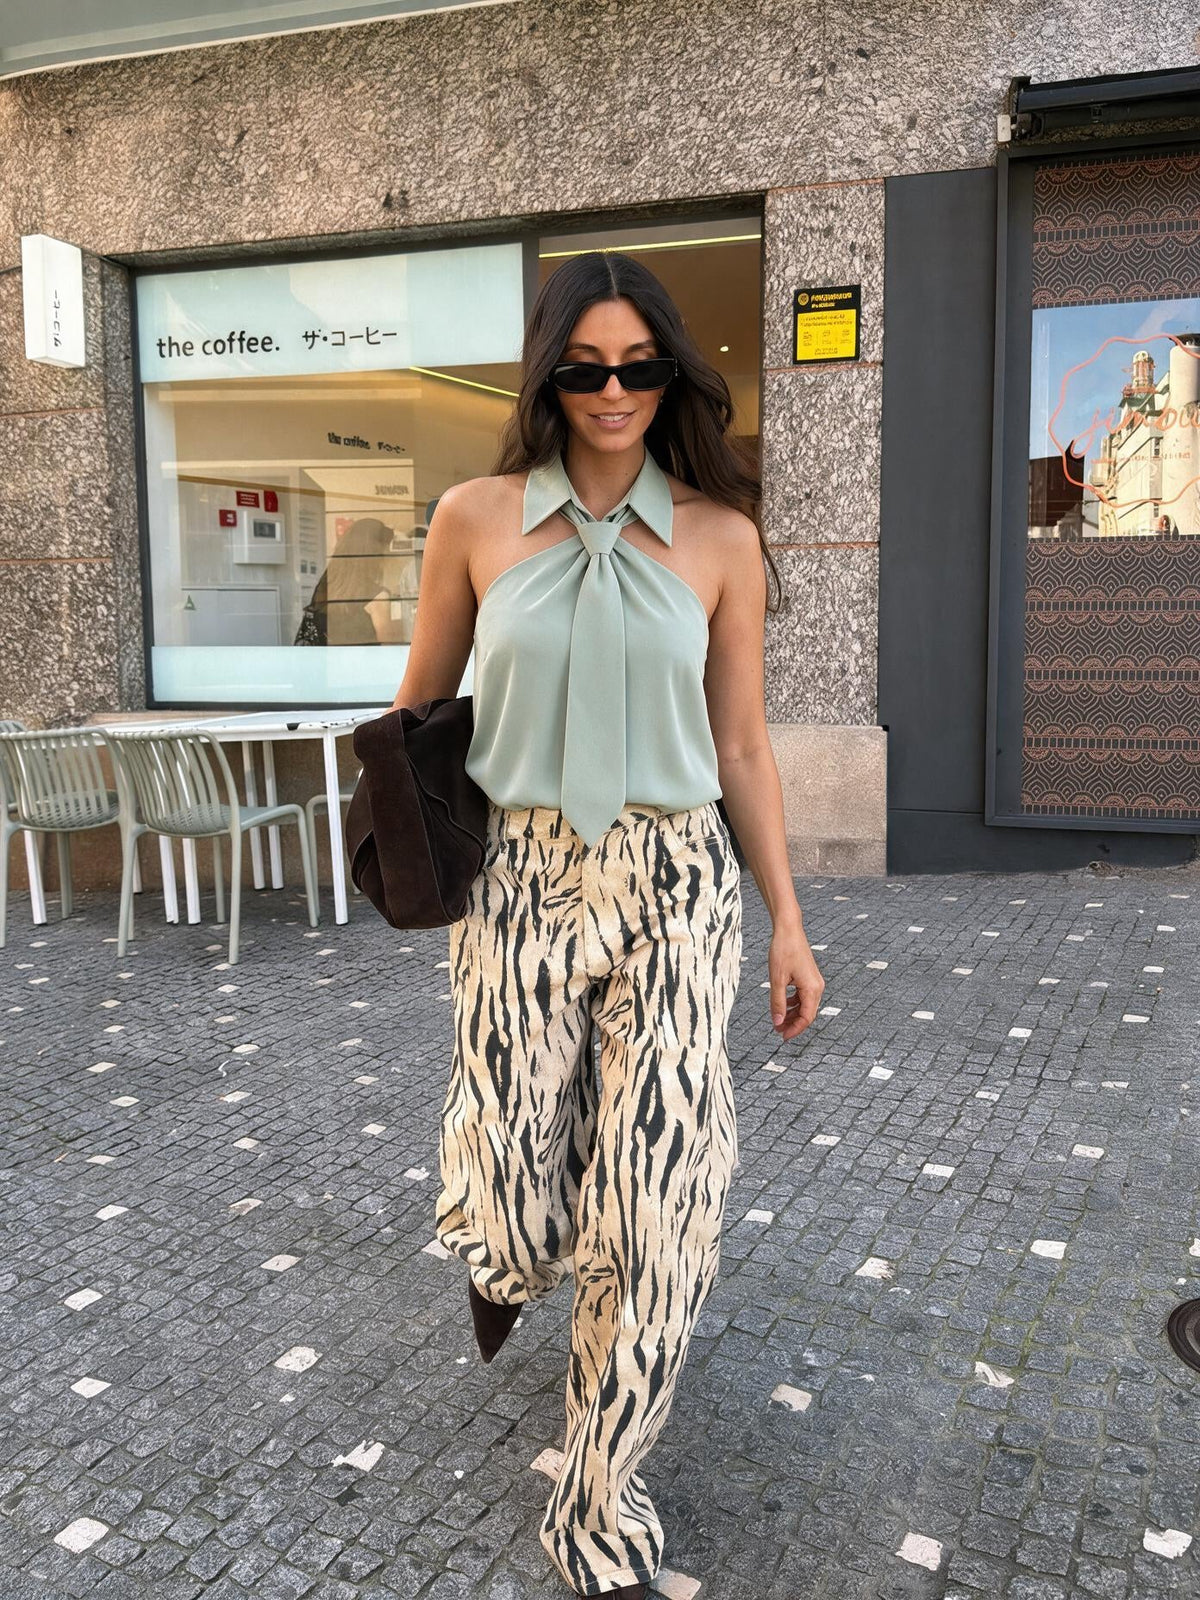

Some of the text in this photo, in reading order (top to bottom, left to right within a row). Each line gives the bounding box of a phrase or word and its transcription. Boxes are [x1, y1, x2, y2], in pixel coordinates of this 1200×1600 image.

[156, 330, 281, 358] the coffee.
[302, 326, 398, 350] ザ・コーヒー
